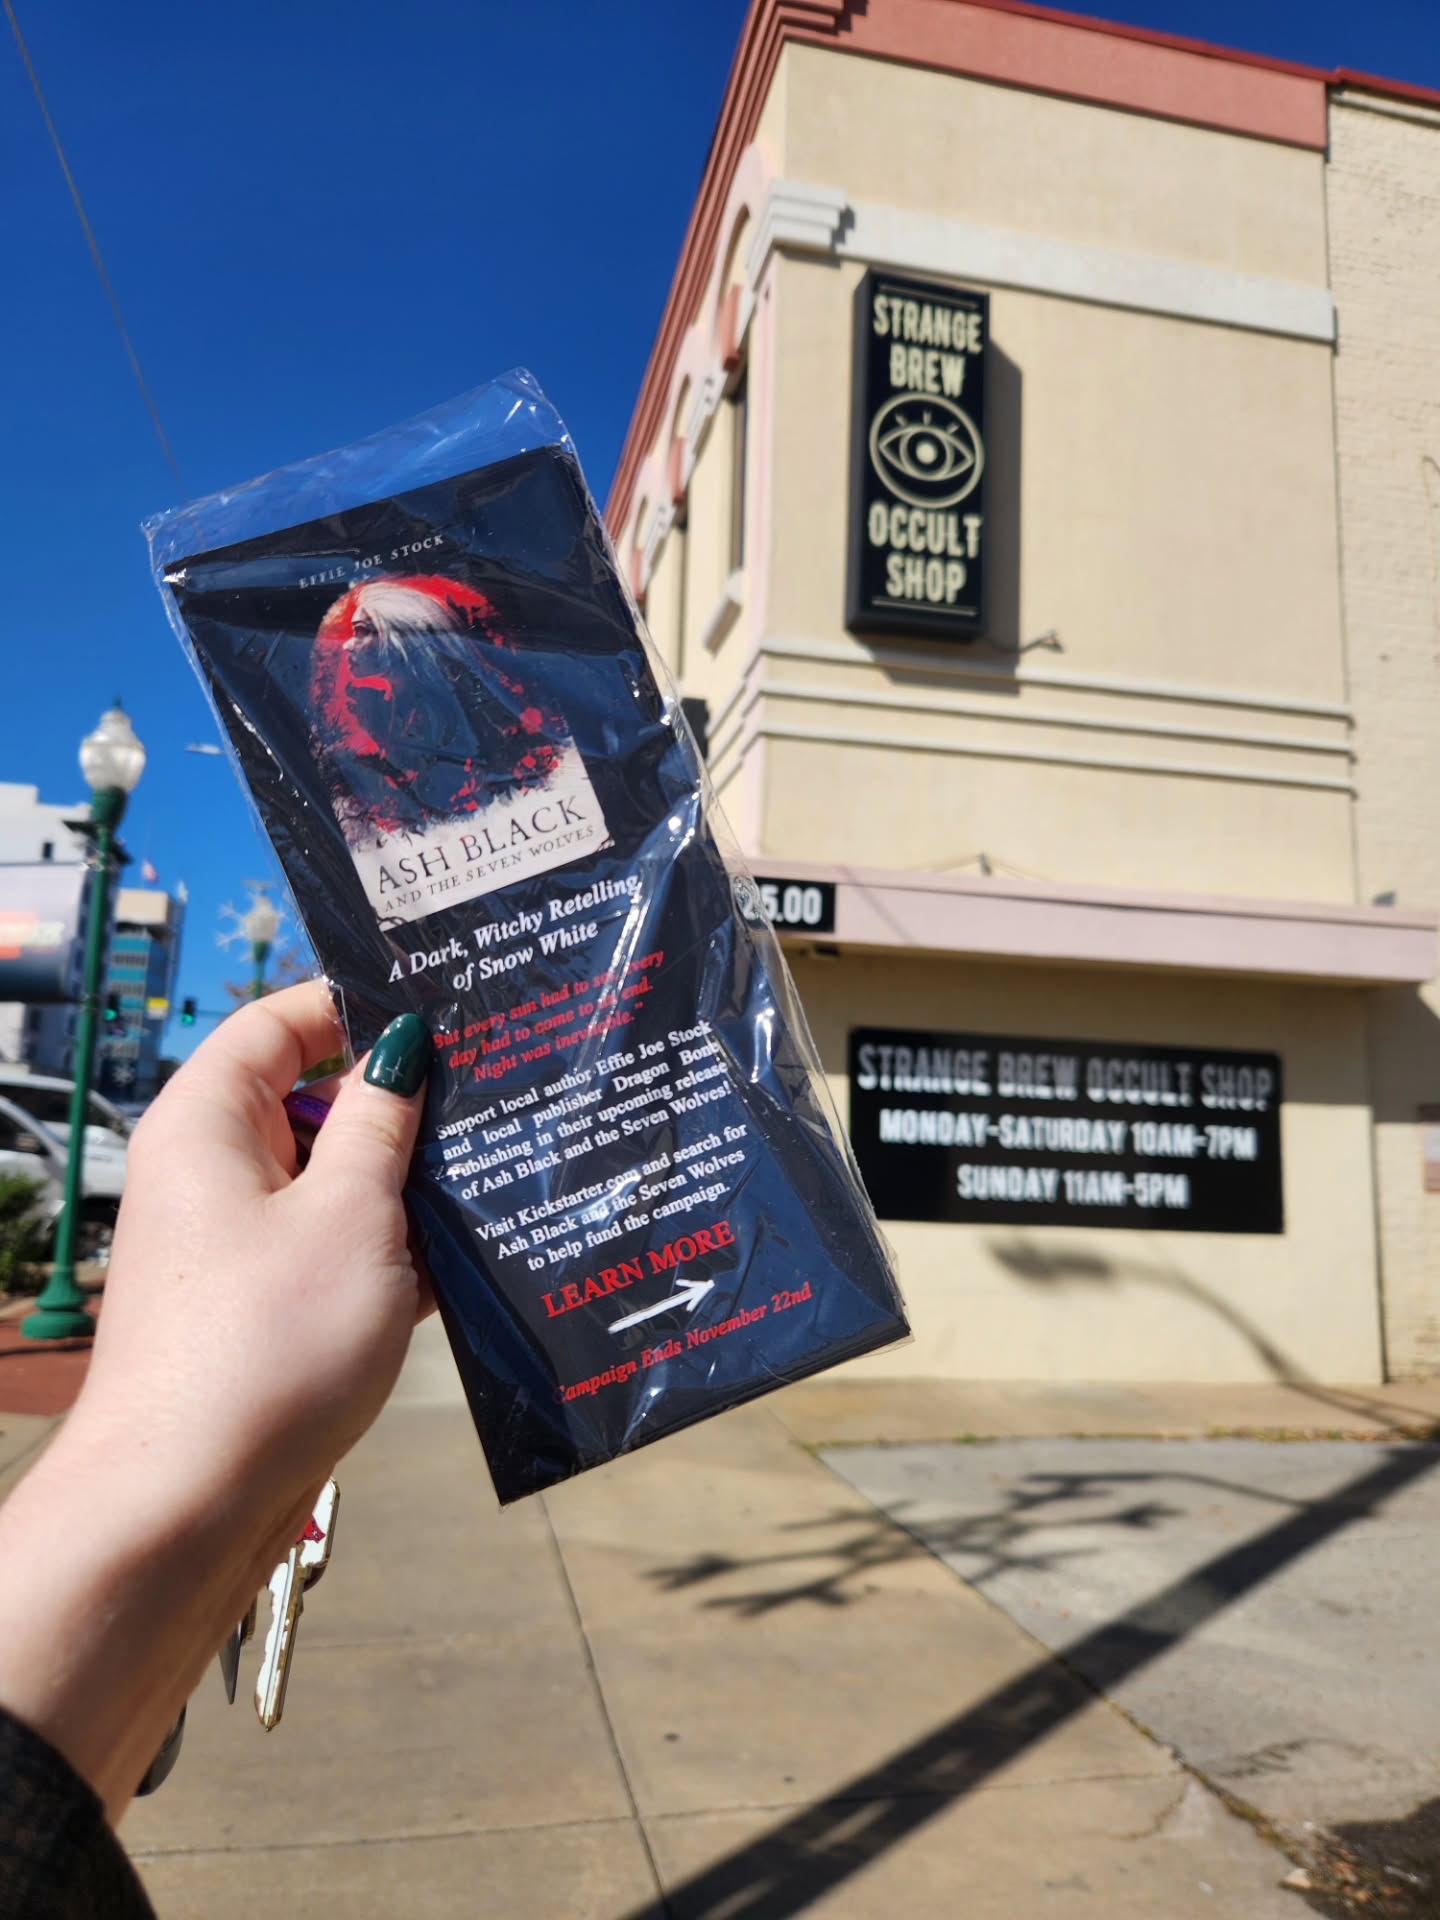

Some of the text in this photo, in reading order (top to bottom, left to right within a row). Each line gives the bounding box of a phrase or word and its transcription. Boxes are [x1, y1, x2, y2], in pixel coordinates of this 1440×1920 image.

[872, 294, 983, 353] STRANGE
[889, 343, 966, 397] BREW
[353, 554, 383, 572] JOE
[390, 534, 444, 560] STOCK
[868, 500, 983, 558] OCCULT
[886, 551, 967, 603] SHOP
[378, 795, 586, 894] ASH BLACK
[384, 824, 595, 913] AND THE SEVEN WOLVES
[387, 875, 640, 983] A Dark, Witchy Retelling
[453, 921, 599, 990] of Snow White
[449, 1048, 476, 1070] day
[481, 1029, 511, 1055] had
[515, 1028, 530, 1043] to
[534, 1009, 575, 1034] come
[578, 1001, 594, 1016] to
[621, 976, 653, 999] end.
[463, 1013, 504, 1038] every
[509, 1002, 537, 1020] sun
[540, 981, 569, 1008] had
[573, 979, 589, 995] to
[436, 1020, 713, 1140] Support local author Effie Joe Stock
[443, 1041, 721, 1161] and local publisher Dragon Bone
[473, 1054, 517, 1083] Night
[521, 1044, 551, 1064] was
[857, 1043, 1274, 1112] STRANGE BREW OCCULT SHOP
[447, 1062, 729, 1181] Publishing in their upcoming release
[462, 1080, 733, 1200] of Ash Black and the Seven Wolves!
[879, 1109, 1258, 1161] MONDAY-SATURDAY 10AM-7PM
[475, 1123, 748, 1242] Visit Kickstarter.com and search for
[498, 1148, 746, 1260] Ash Black and the Seven Wolves
[957, 1164, 1190, 1209] SUNDAY 11AM-5PM
[527, 1182, 731, 1272] to help fund the campaign.
[541, 1220, 735, 1318] LEARN MORE
[640, 1338, 682, 1369] Ends
[685, 1302, 767, 1349] November
[771, 1281, 813, 1312] 22nd
